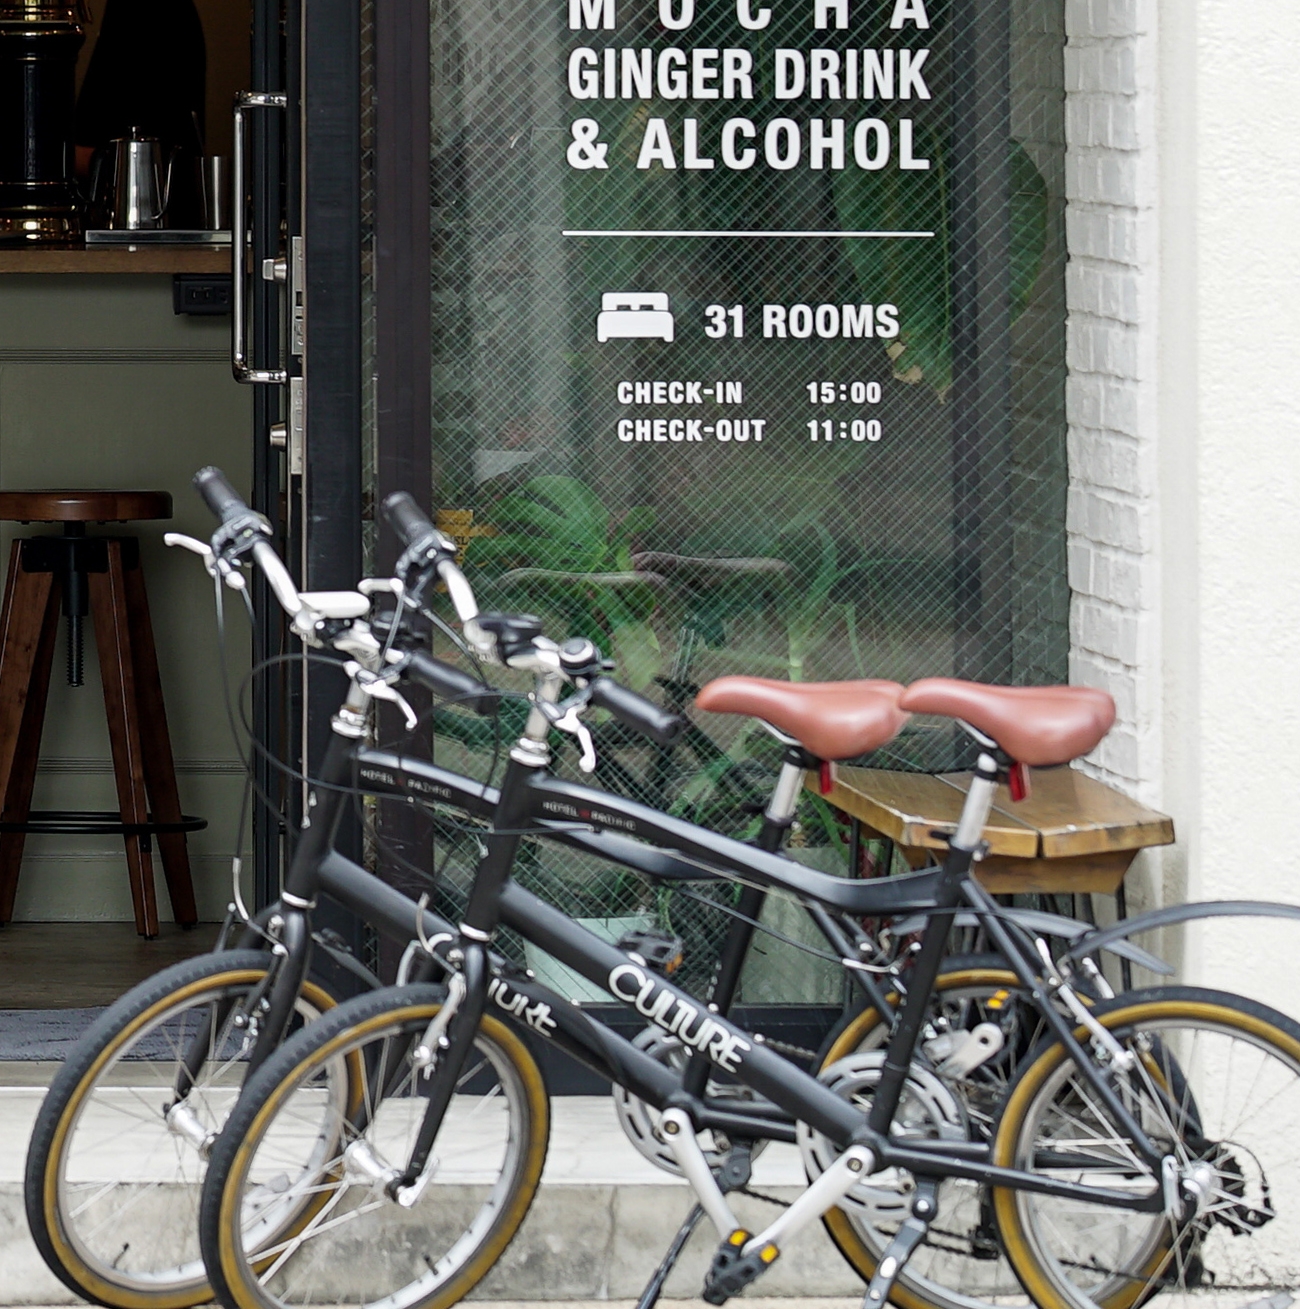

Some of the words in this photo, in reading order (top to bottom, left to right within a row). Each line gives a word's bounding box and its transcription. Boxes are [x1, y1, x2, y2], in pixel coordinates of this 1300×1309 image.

[568, 48, 754, 100] GINGER
[774, 48, 931, 100] DRINK
[566, 118, 609, 170] &
[636, 118, 930, 170] ALCOHOL
[704, 304, 744, 339] 31
[762, 304, 900, 339] ROOMS
[617, 381, 743, 404] CHECK-IN
[806, 381, 882, 404] 15:00
[617, 419, 766, 442] CHECK-OUT
[806, 419, 882, 442] 11:00
[608, 964, 752, 1074] CULTURE
